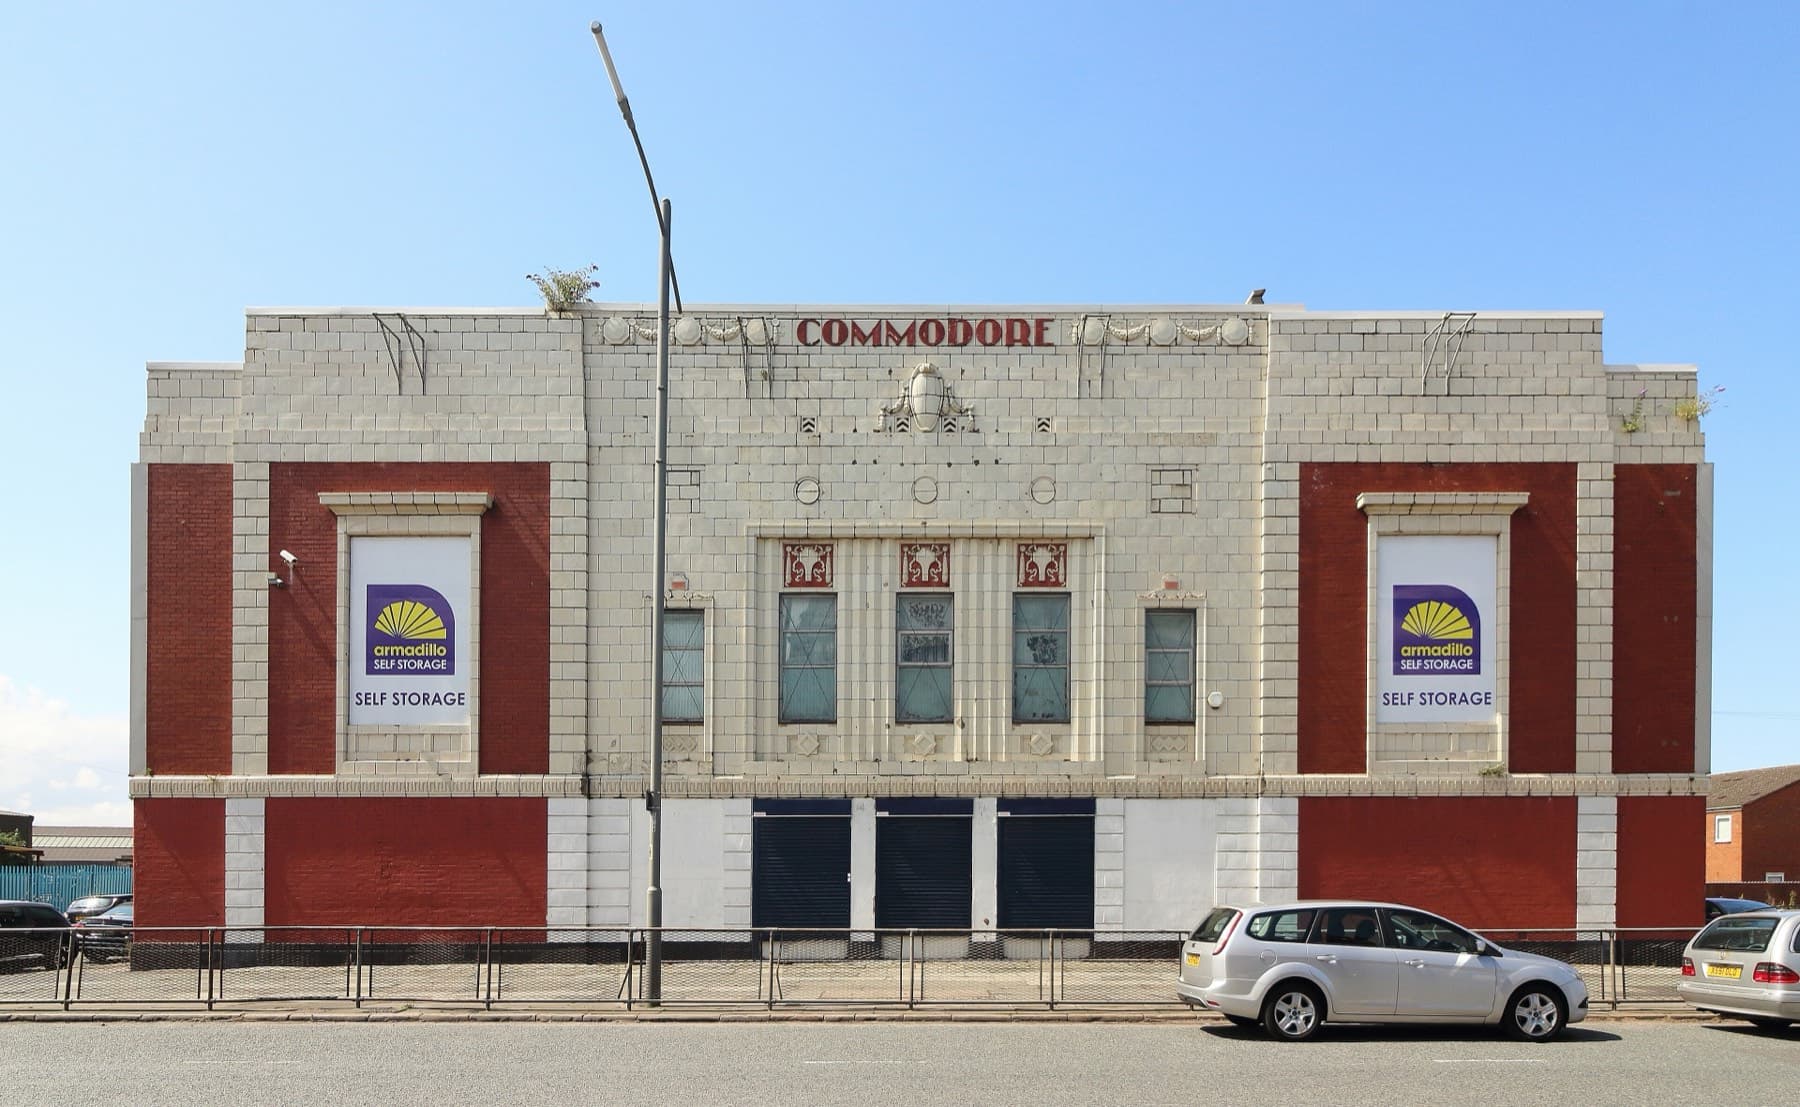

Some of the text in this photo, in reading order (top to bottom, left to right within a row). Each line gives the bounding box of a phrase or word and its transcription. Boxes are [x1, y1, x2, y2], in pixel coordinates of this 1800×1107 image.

[797, 318, 1054, 347] COMMODORE
[374, 643, 447, 656] armadillo
[1401, 643, 1473, 656] armadillo
[374, 659, 447, 670] SELF STORAGE
[1401, 659, 1473, 670] SELF STORAGE
[355, 692, 466, 706] SELF STORAGE
[1383, 692, 1491, 706] SELF STORAGE
